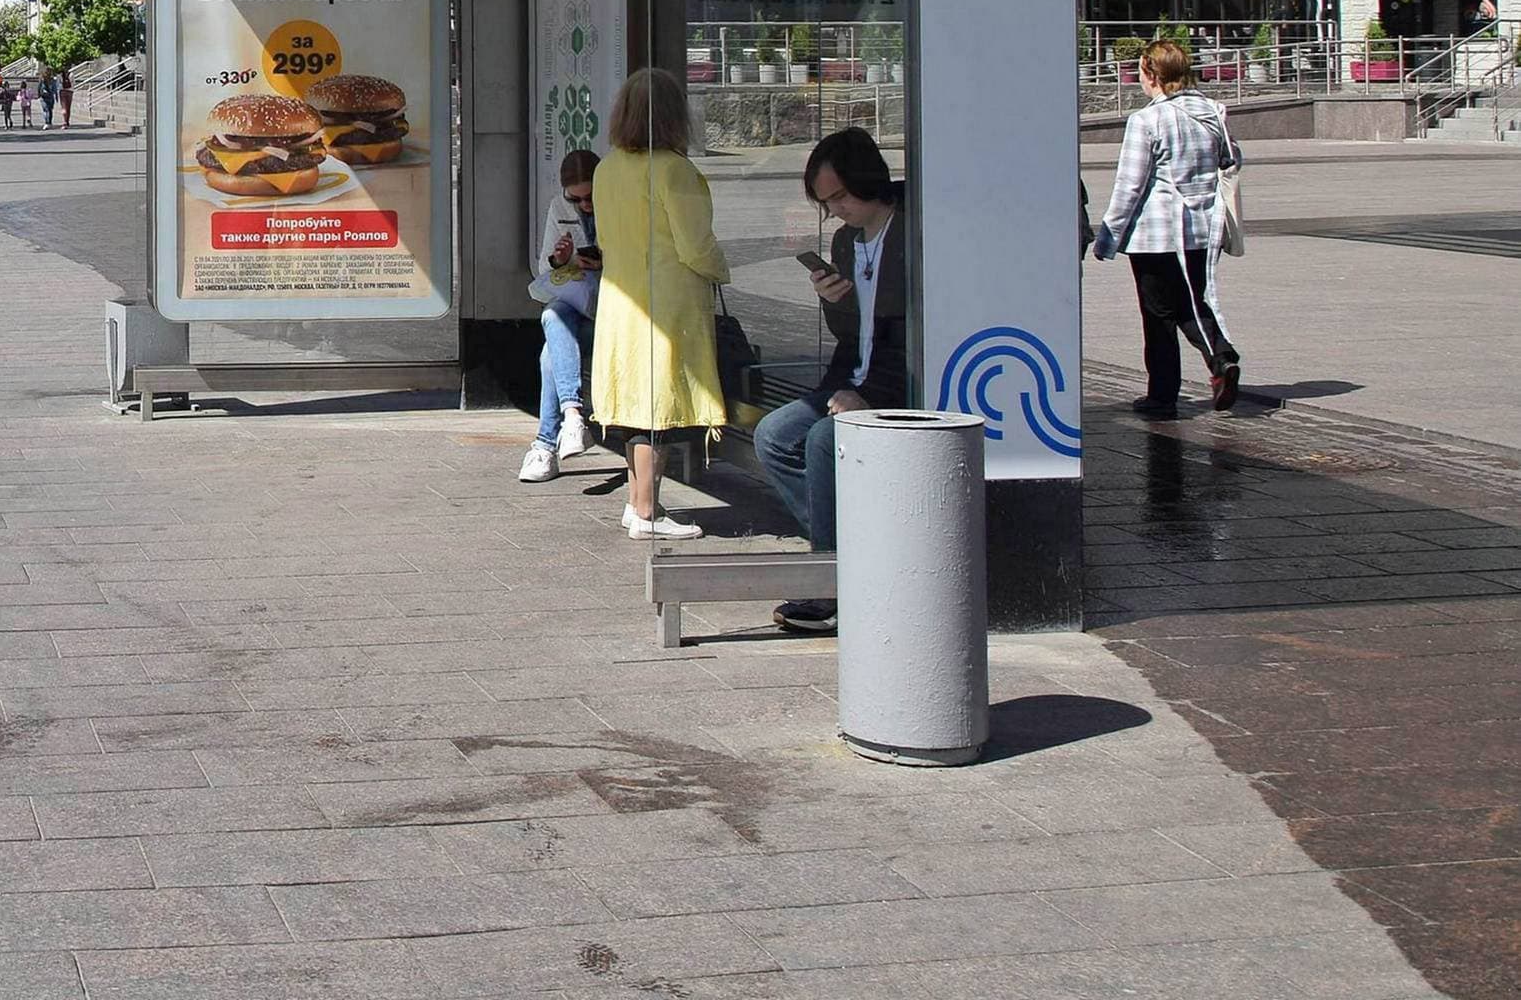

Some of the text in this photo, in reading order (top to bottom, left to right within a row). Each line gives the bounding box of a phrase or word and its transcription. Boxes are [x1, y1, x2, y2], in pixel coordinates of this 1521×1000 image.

[291, 36, 314, 49] за
[266, 217, 342, 229] Попробуйте
[220, 231, 389, 244] также другие пары Роялов
